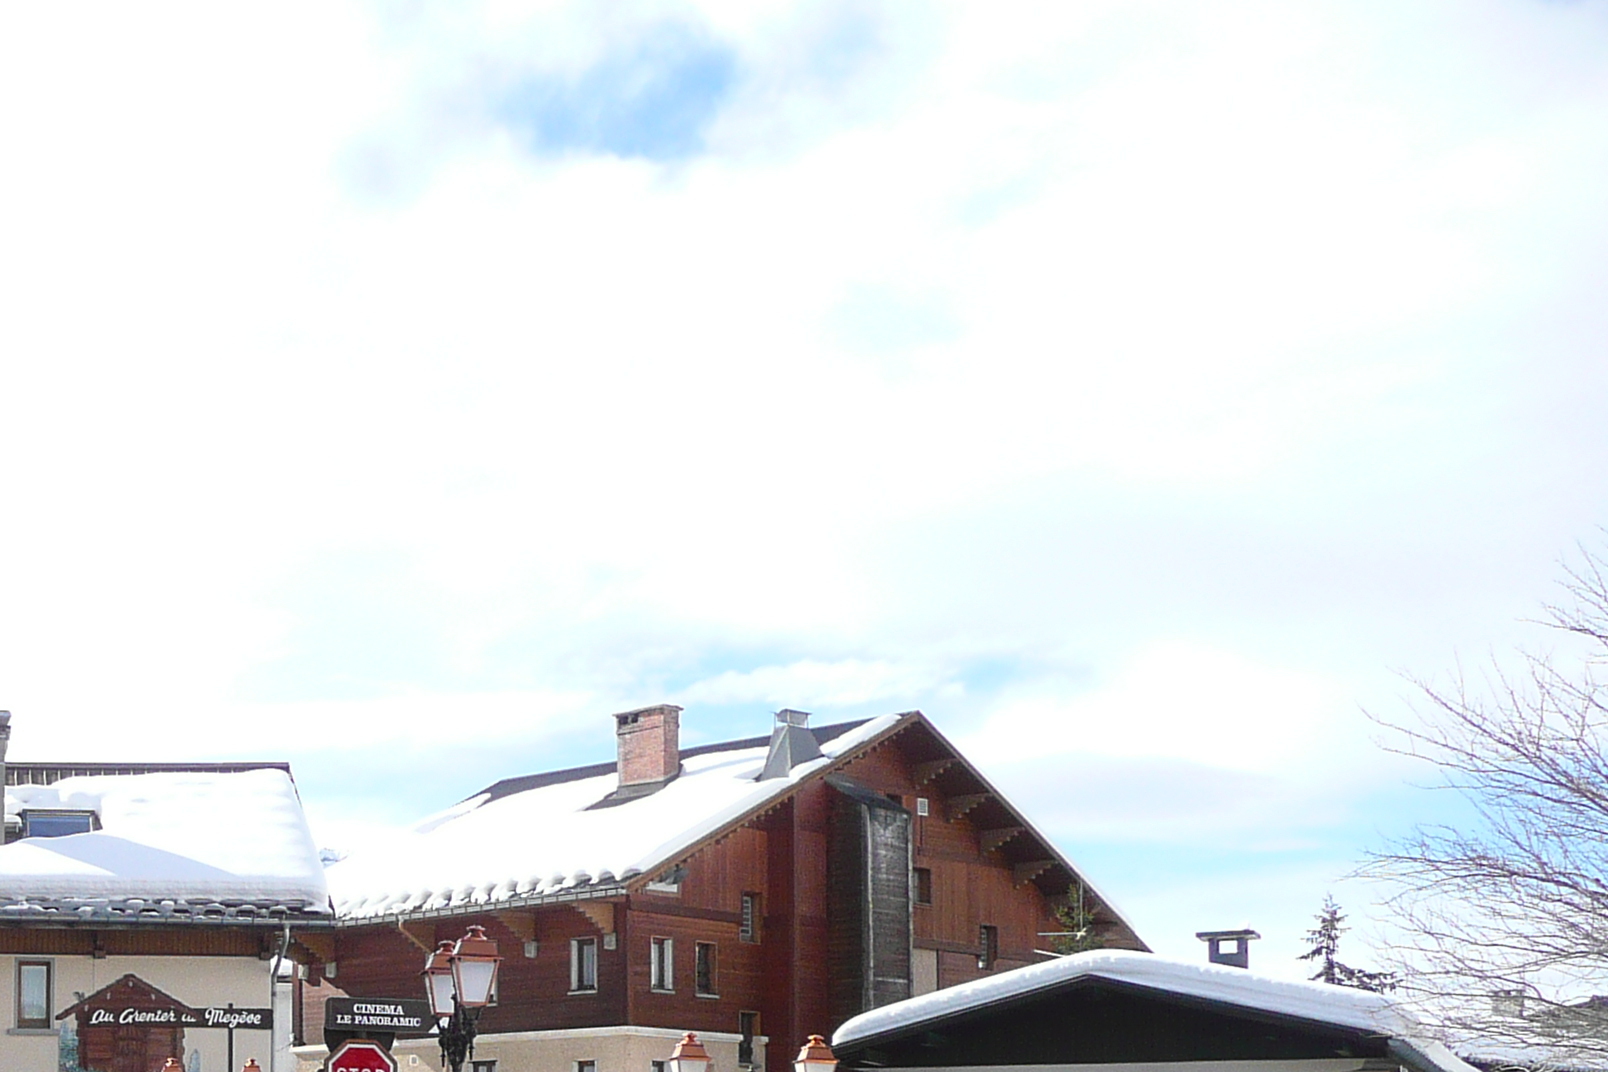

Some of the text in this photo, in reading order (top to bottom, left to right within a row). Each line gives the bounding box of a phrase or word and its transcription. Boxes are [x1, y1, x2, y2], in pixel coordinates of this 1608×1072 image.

[353, 1003, 404, 1015] CINEMA
[90, 1009, 114, 1024] Au
[119, 1008, 177, 1024] Grenier
[204, 1007, 262, 1028] Megève
[336, 1014, 422, 1027] LE PANORAMIC
